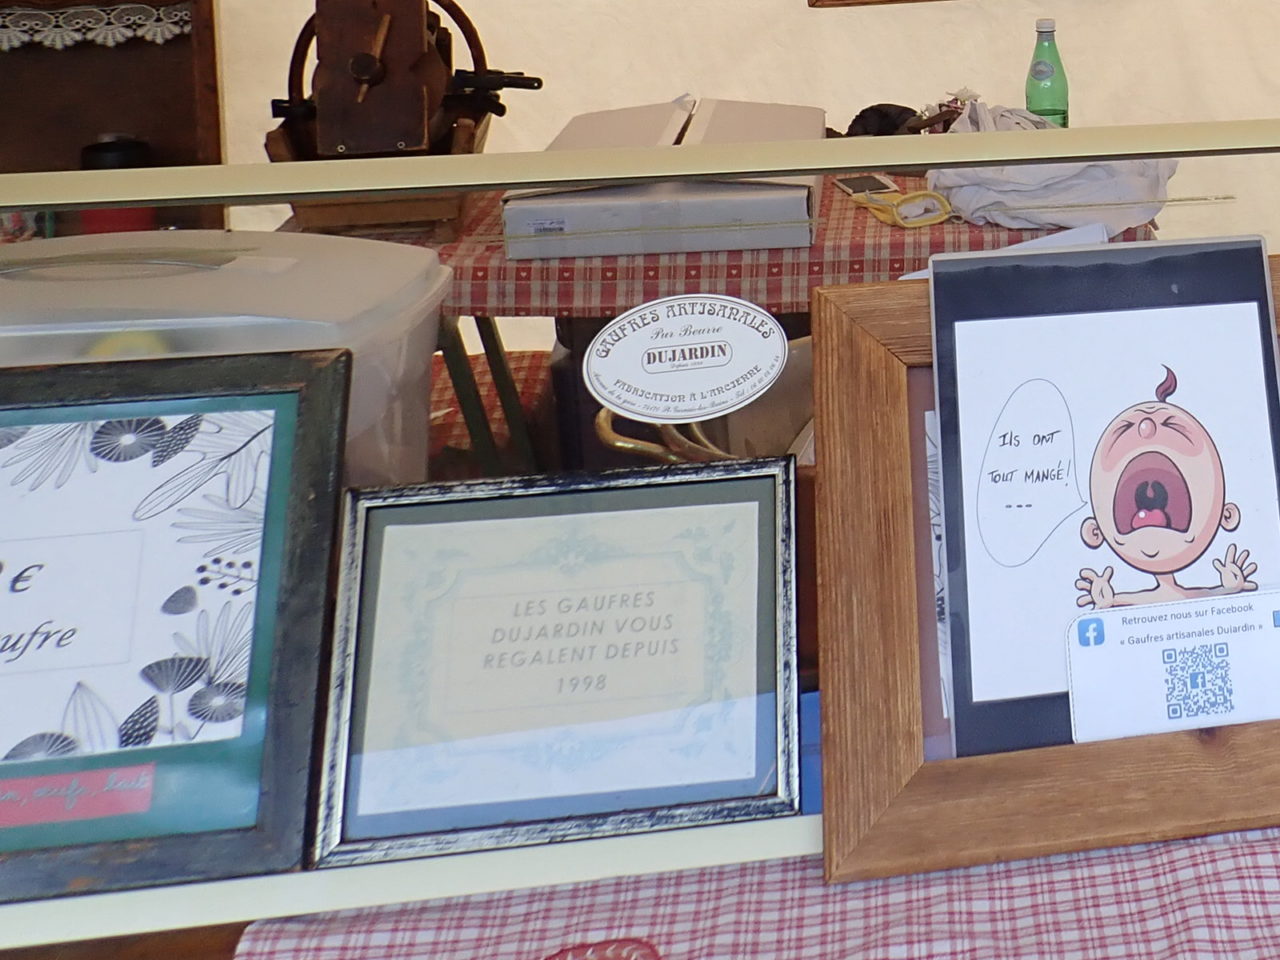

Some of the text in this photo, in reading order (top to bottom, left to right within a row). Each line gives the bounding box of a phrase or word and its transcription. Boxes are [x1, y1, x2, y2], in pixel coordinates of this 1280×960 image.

[596, 302, 776, 359] GAUFRES ARTISANALES
[650, 324, 723, 341] Pur Beurre
[646, 343, 728, 366] DUJARDIN
[613, 378, 686, 403] FABRICATION
[700, 365, 762, 400] L'ANCIENNE
[987, 469, 1018, 483] TOUT
[512, 591, 656, 618] LES GAUFRES
[1121, 603, 1254, 626] Retrouvez nous sur Facebook
[490, 614, 674, 644] DUJARDIN VOUS
[1127, 632, 1164, 645] Gaufres
[1166, 627, 1215, 640] artisanales
[483, 638, 680, 669] REGALENT DEPUIS
[557, 674, 608, 693] 1998
